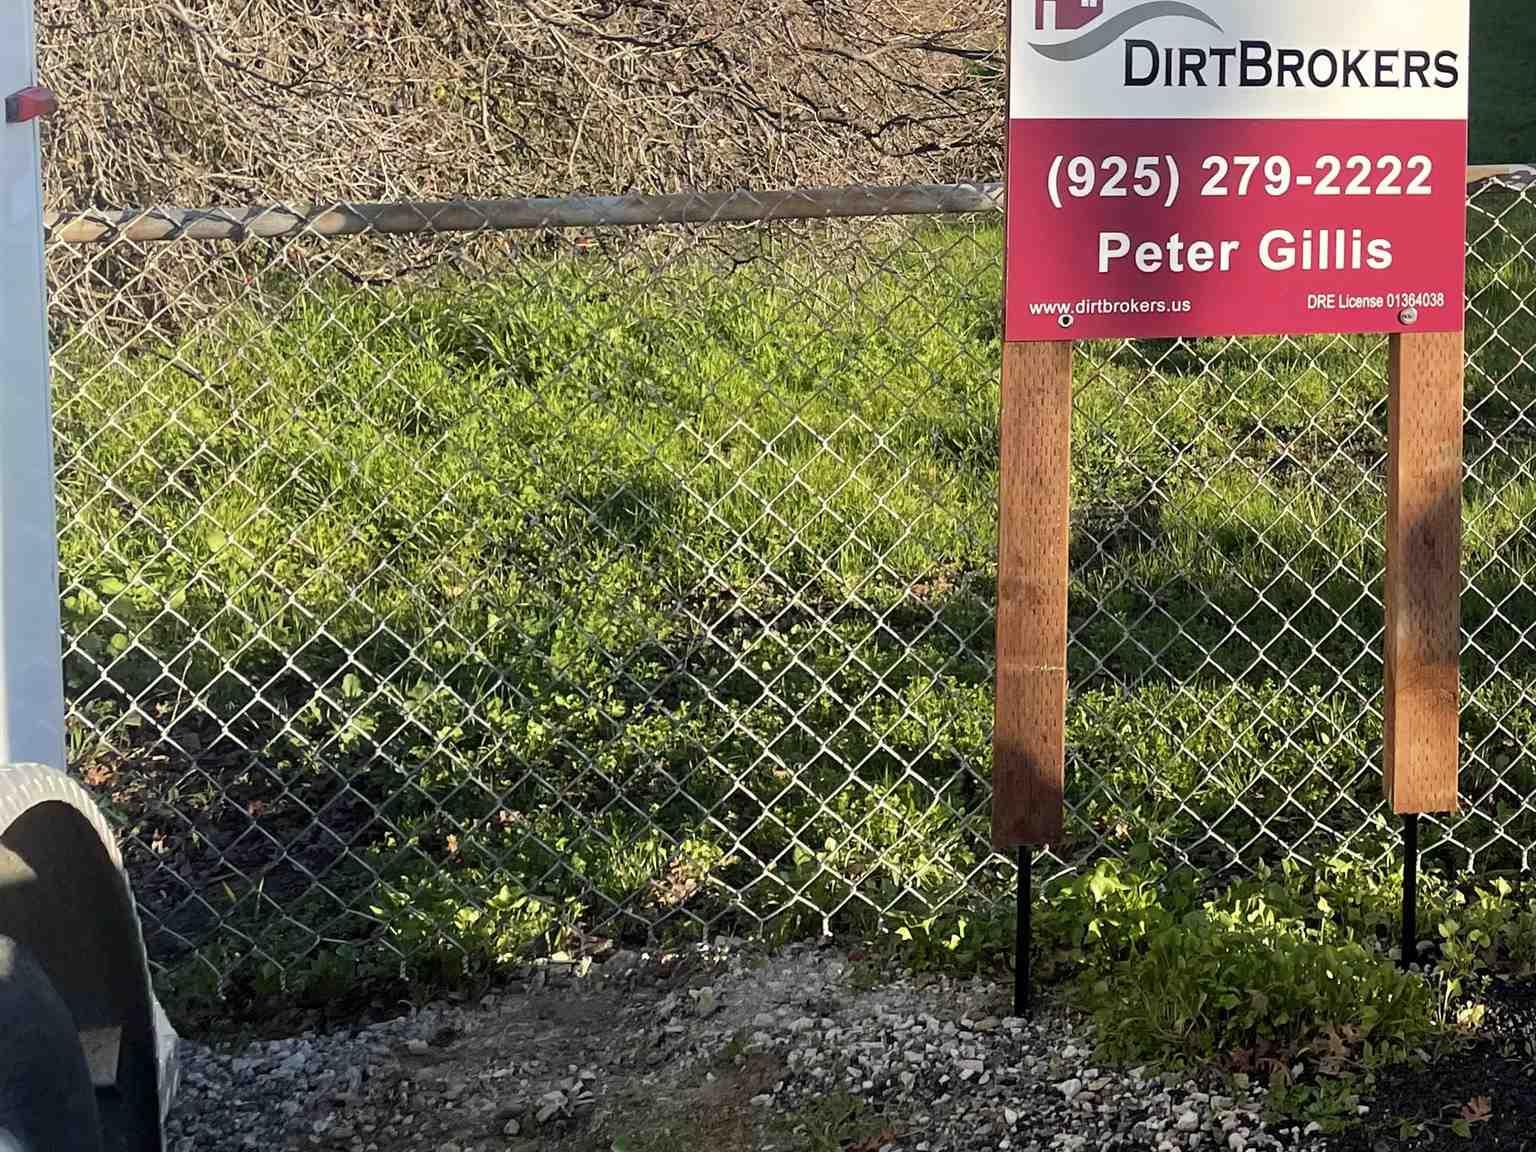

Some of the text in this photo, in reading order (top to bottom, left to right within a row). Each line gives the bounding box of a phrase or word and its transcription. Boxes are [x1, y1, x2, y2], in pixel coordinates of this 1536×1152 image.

[1046, 155, 1433, 209] (925) 279-2222
[1098, 228, 1393, 273] Peter Gillis
[1029, 297, 1192, 314] www.dirtbrokers.us
[1307, 292, 1445, 309] DRE License 01364038
